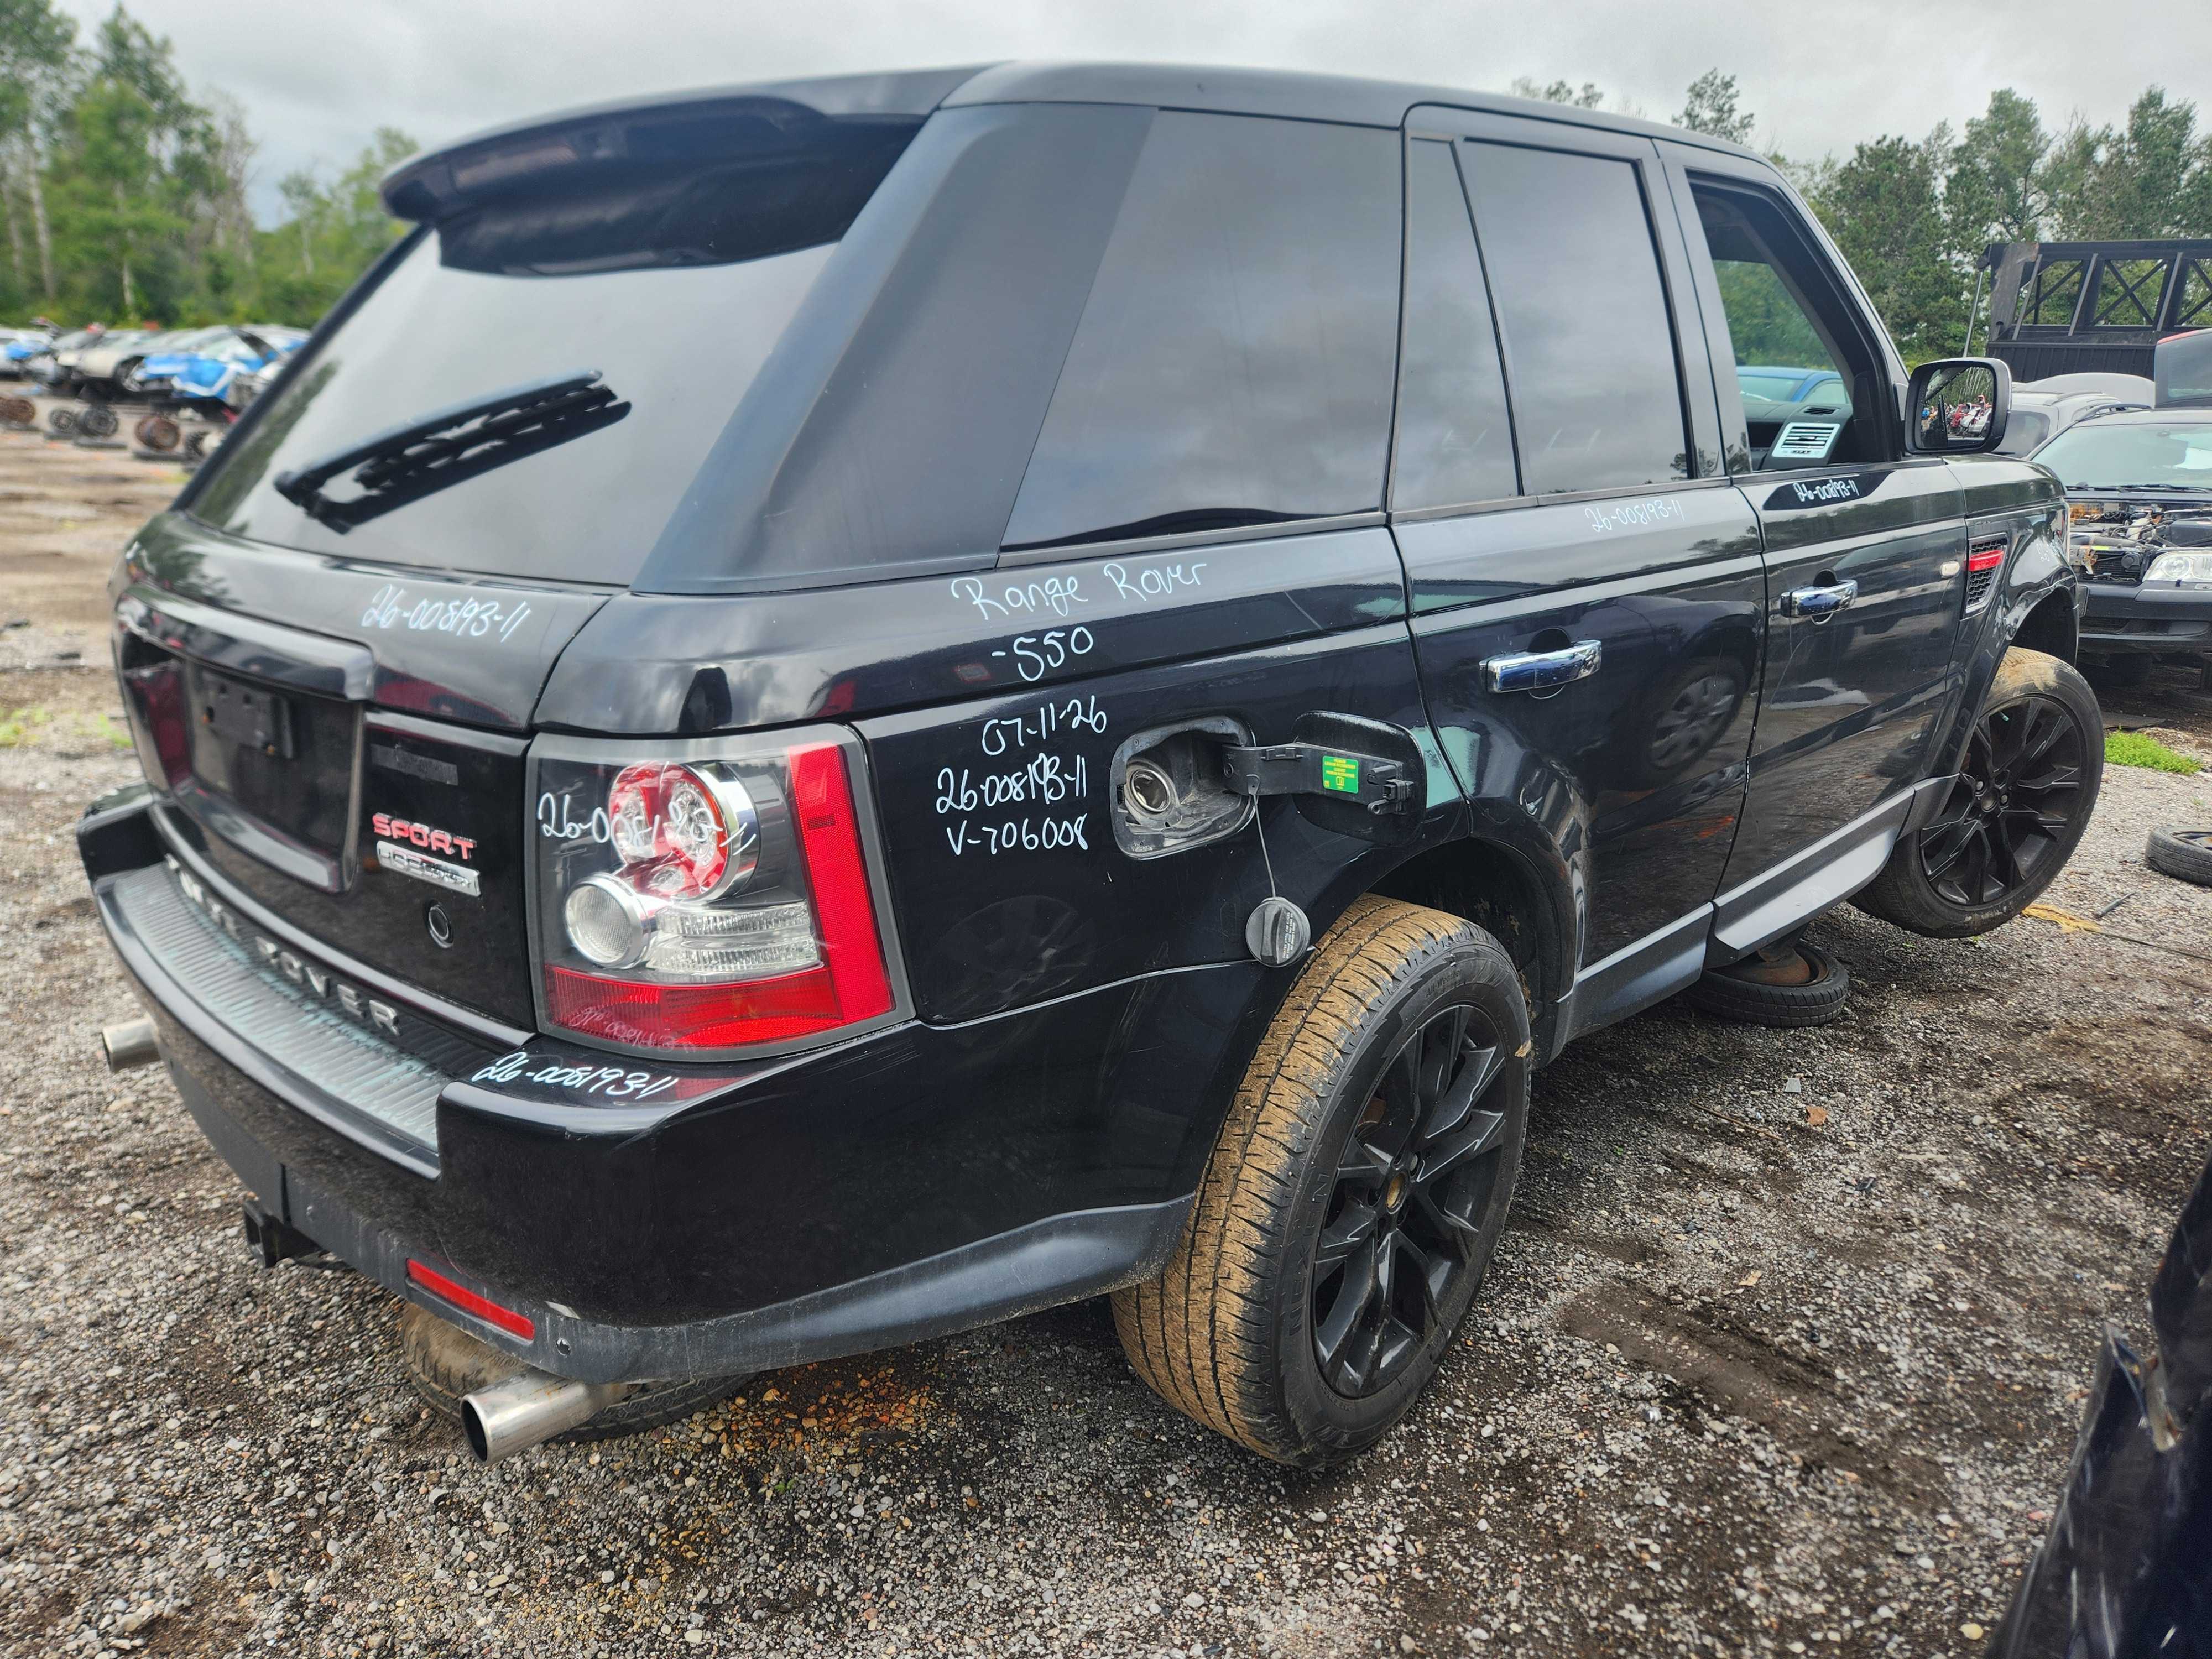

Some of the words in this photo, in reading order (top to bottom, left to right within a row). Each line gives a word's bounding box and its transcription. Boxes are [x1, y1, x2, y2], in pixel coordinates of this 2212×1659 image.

[1584, 499, 1685, 532] 26-008193-11
[361, 584, 532, 643] 26-008193-11
[951, 576, 1088, 620] Range
[1103, 562, 1207, 601] Rover
[982, 695, 1107, 755] 07-11-26
[372, 812, 477, 860] SPORT
[946, 813, 1088, 855] V-706008
